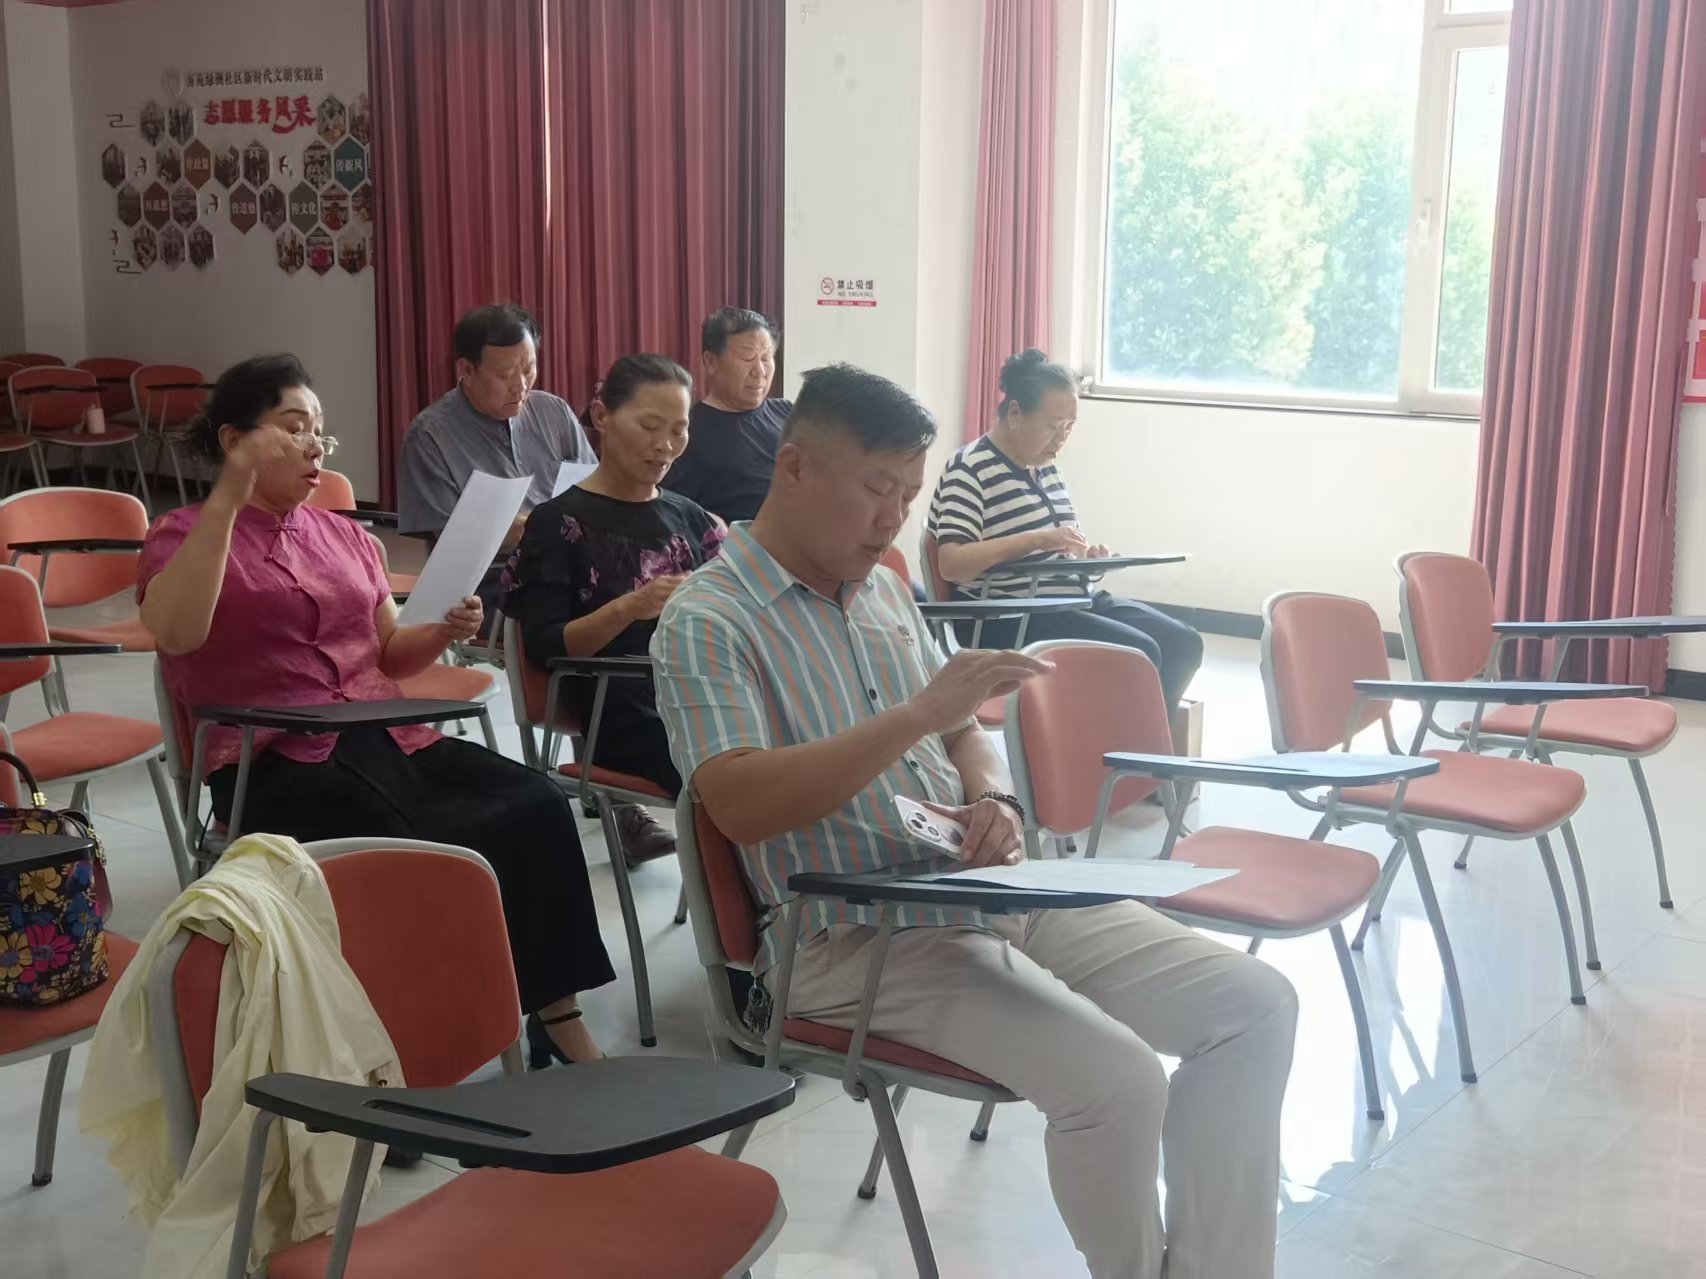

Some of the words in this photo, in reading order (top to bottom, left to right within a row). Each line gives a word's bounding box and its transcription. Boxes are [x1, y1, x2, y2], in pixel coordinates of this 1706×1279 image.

[204, 96, 316, 133] 志愿服务风采
[837, 280, 874, 290] 禁止吸烟
